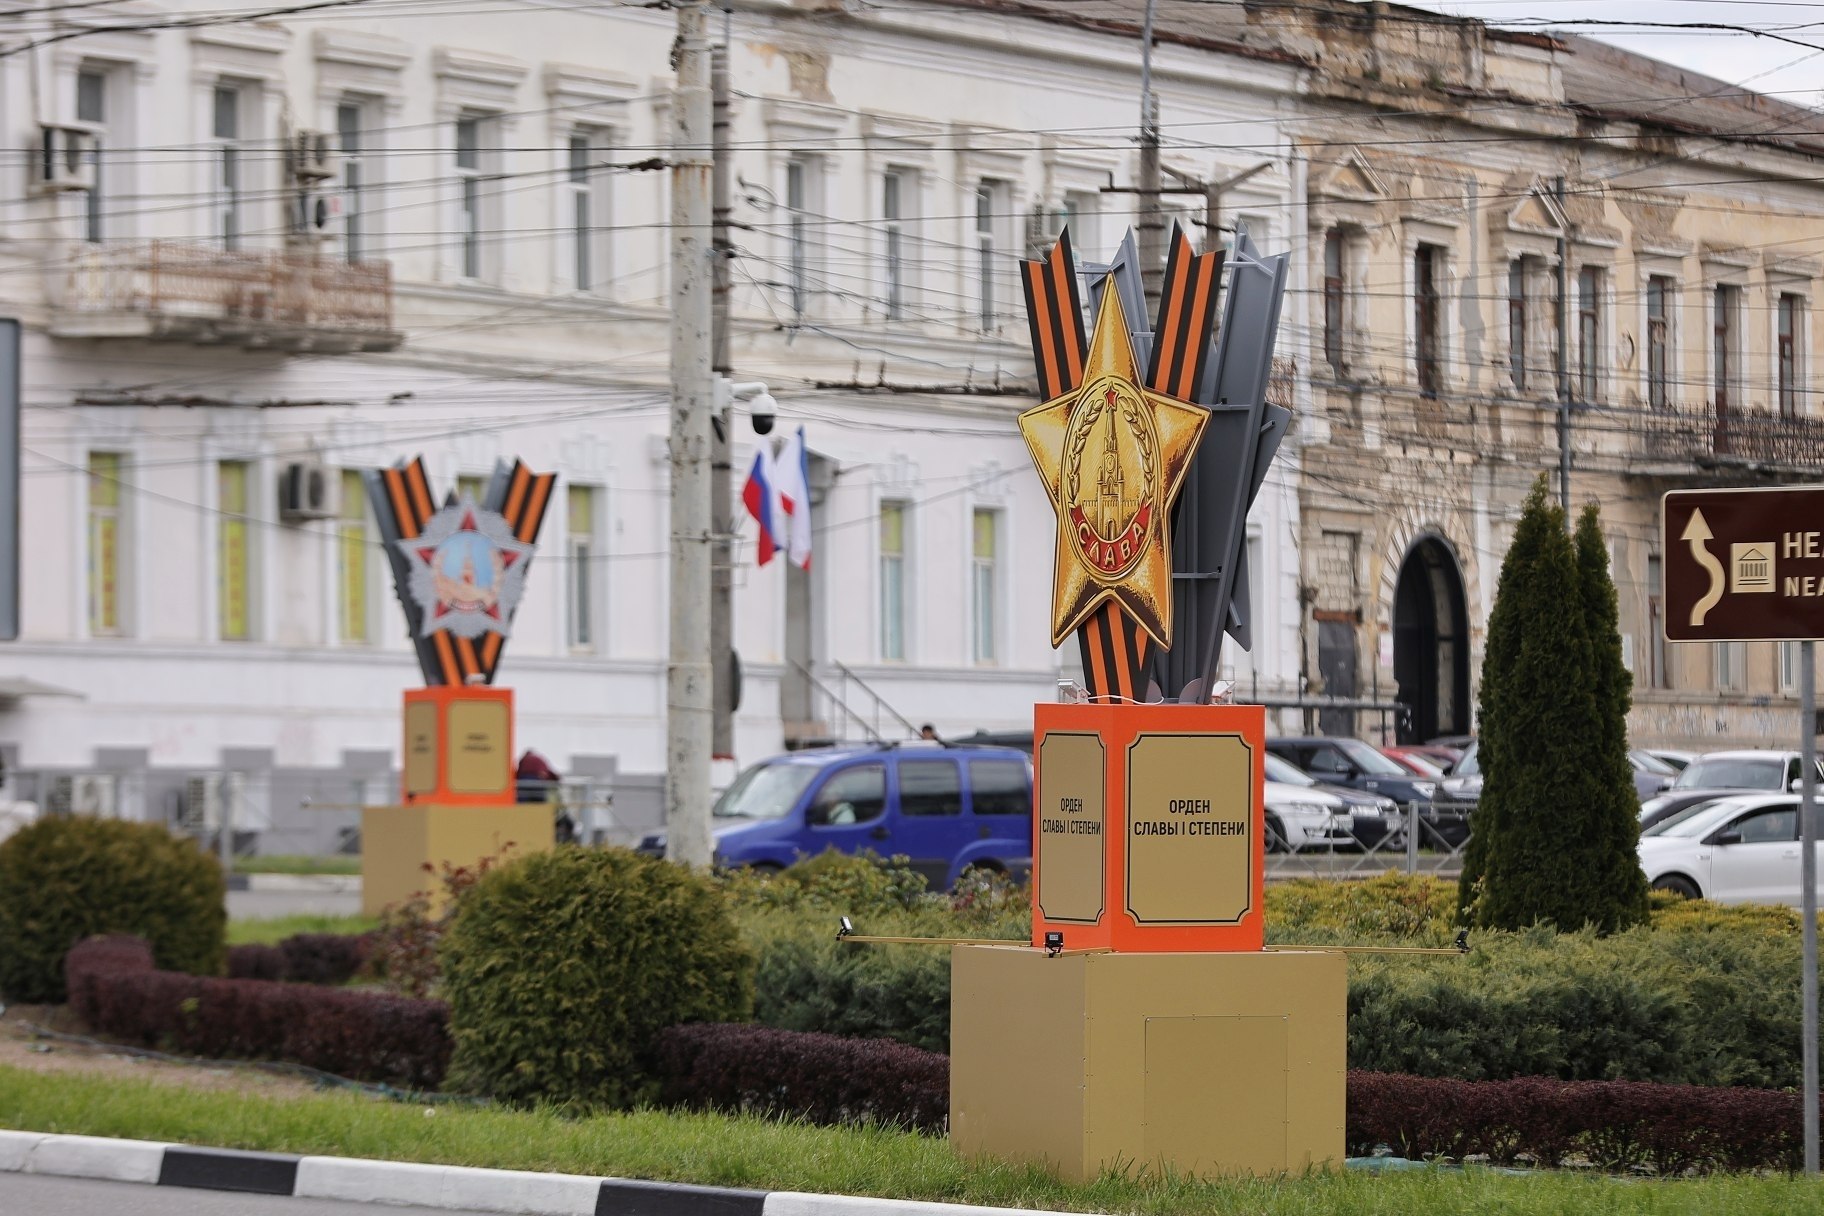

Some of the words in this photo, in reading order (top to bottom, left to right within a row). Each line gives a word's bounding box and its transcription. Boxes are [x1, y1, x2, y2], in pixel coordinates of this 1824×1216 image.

[1078, 521, 1145, 567] СЛАВА
[1783, 531, 1824, 558] НЕ
[1060, 797, 1083, 814] ОРДЕН
[1169, 799, 1211, 815] ОРДЕН
[1042, 819, 1066, 833] СЛАВЫ
[1070, 820, 1101, 835] СТЕПЕНИ
[1134, 821, 1178, 836] СЛАВЫ
[1181, 821, 1186, 836] I
[1188, 821, 1245, 836] СТЕПЕНИ
